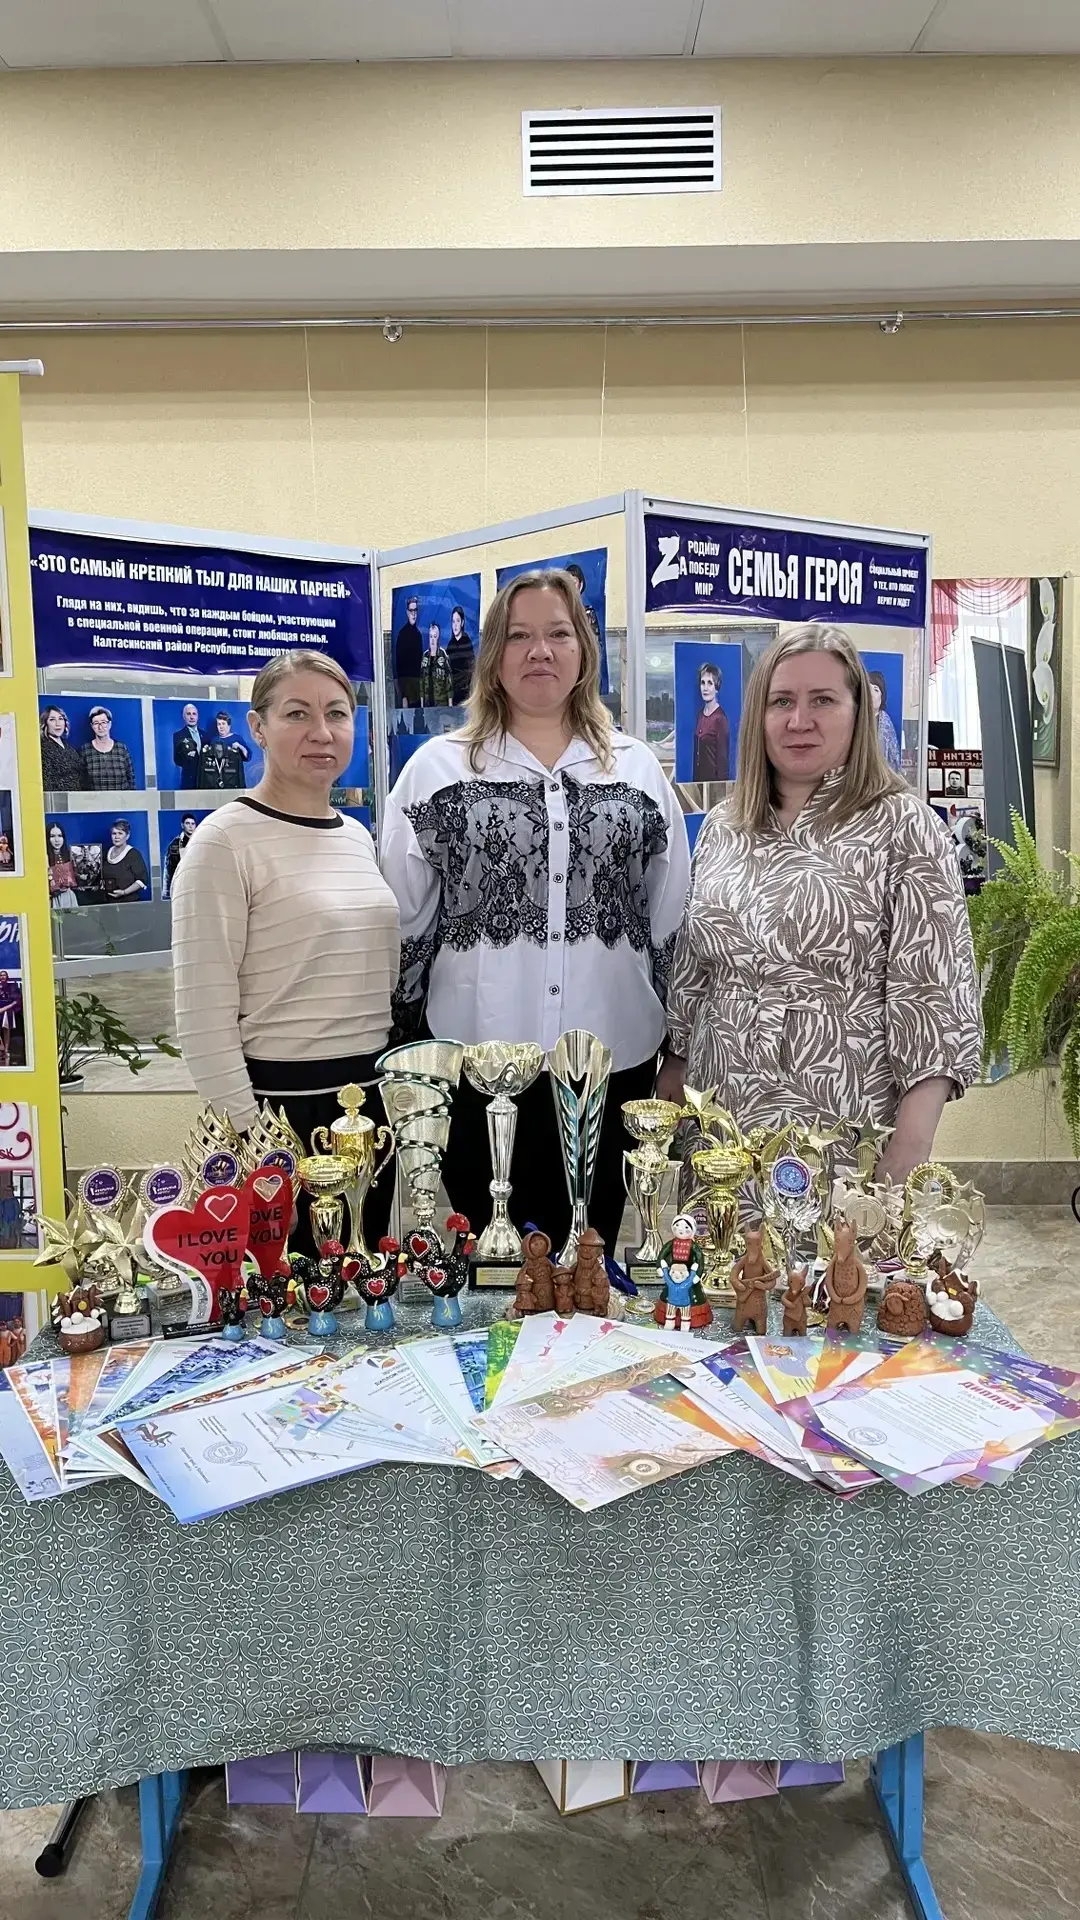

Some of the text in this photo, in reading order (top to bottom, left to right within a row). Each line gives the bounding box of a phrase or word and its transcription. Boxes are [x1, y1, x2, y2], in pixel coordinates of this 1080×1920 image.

[687, 540, 720, 556] РОДИНУ
[30, 553, 351, 599] «ЭТО САМЫЙ КРЕПКИЙ ТЫЛ ДЛЯ НАШИХ ПАРНЕЙ»
[689, 560, 720, 578] ПОБЕДУ
[728, 547, 862, 605] СЕМЬЯ ГЕРОЯ
[694, 581, 714, 596] МИР
[57, 595, 336, 628] Глядя на них, видишь, что за каждым бойцом, участвующим
[68, 617, 329, 644] в специальной военной операции, стоит любящая семья.
[93, 635, 291, 657] Калтасинский район Республика Башкорто
[250, 1206, 283, 1225] OVE
[177, 1227, 238, 1249] I LOVE
[250, 1227, 284, 1244] YOU
[200, 1249, 238, 1266] YOU
